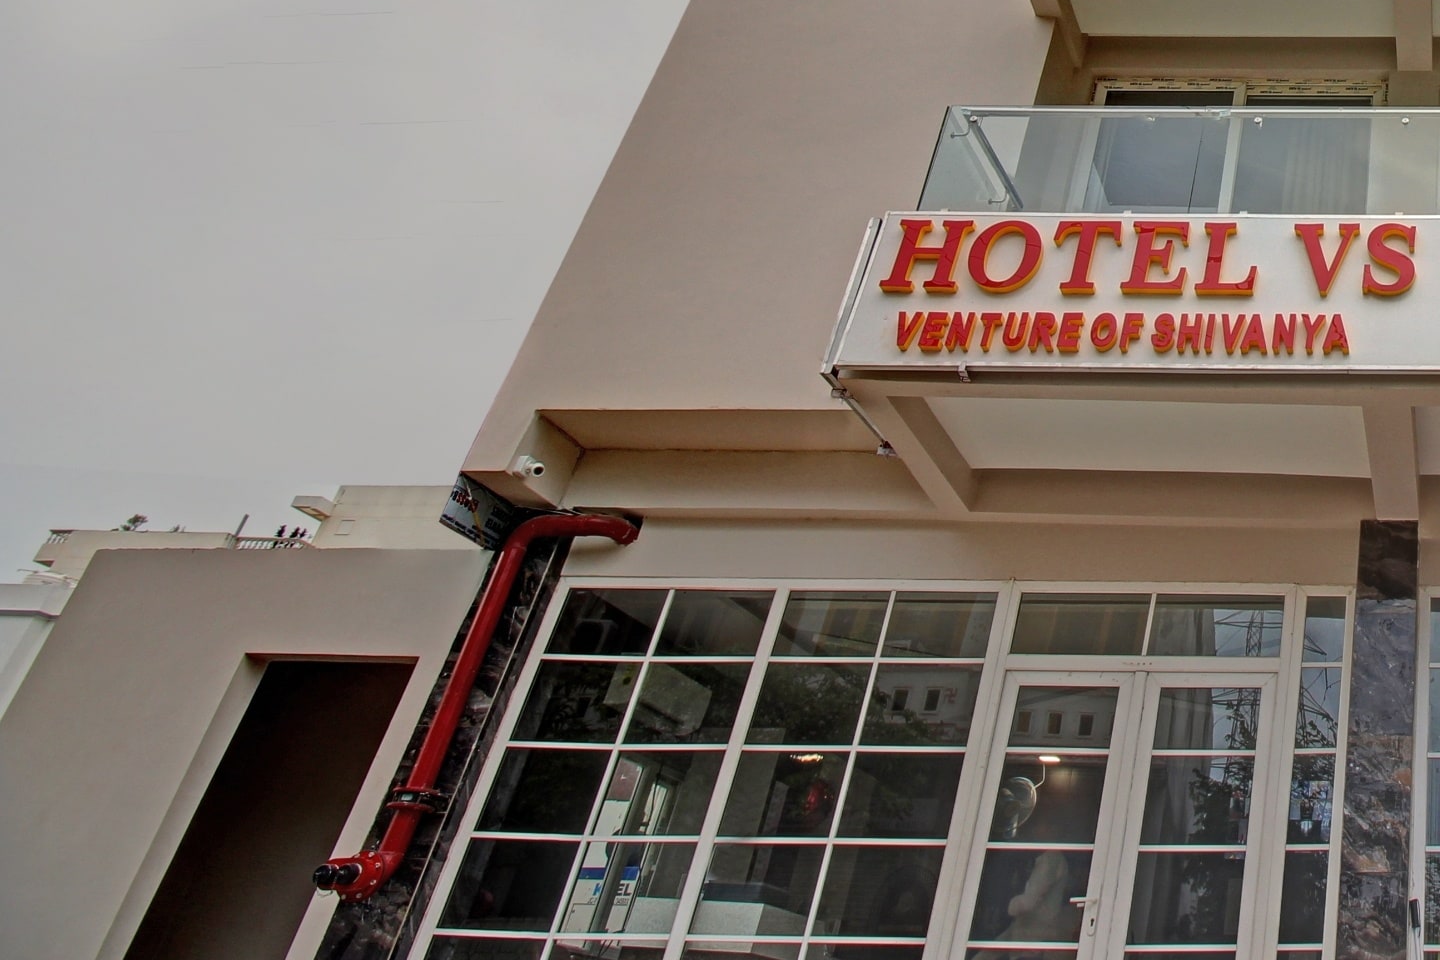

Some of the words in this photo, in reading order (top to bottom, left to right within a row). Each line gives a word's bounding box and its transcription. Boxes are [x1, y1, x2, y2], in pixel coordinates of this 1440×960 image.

[879, 220, 1257, 298] HOTEL
[1295, 224, 1416, 298] VS
[897, 311, 1087, 355] VENTURE
[1091, 313, 1145, 355] OF
[1151, 313, 1350, 356] SHIVANYA
